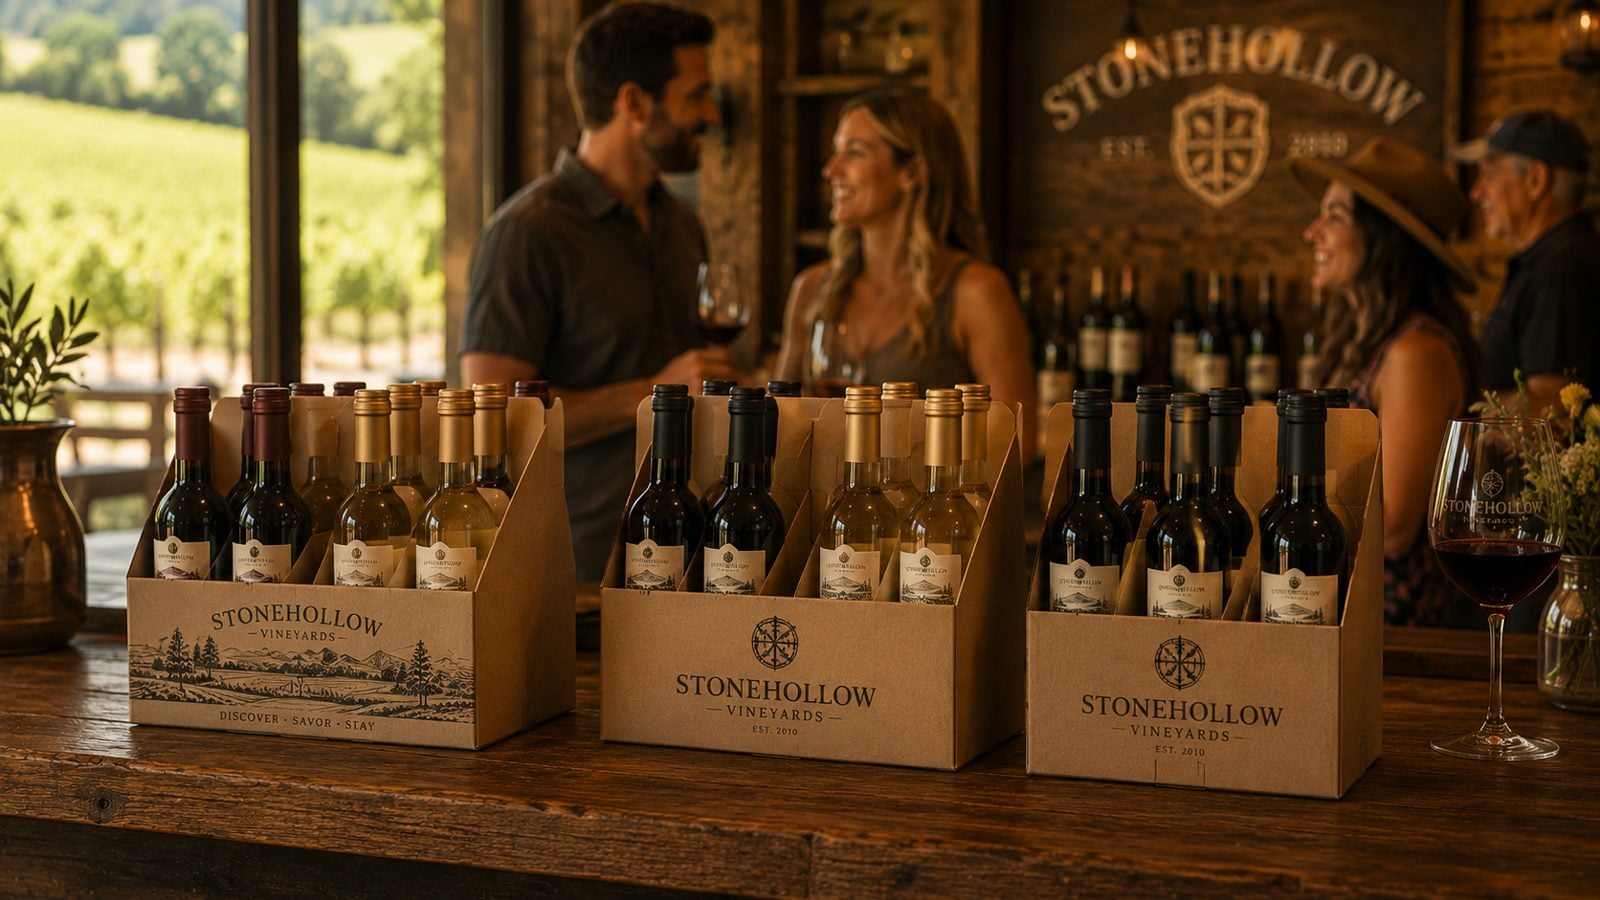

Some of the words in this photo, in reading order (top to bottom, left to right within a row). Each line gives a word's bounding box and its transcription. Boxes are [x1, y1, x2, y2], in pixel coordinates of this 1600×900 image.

[1042, 23, 1427, 133] STONEHOLLOW
[1443, 499, 1543, 515] STONEHOLLOW
[211, 604, 383, 637] STONEHOLLOW
[260, 629, 335, 641] VINEYARDS
[676, 673, 876, 708] STONEHOLLOW
[727, 705, 823, 722] VINEYARDS
[1081, 694, 1283, 727] STONEHOLLOW
[219, 711, 279, 724] DISCOVER
[292, 716, 332, 728] SAVOR
[752, 725, 773, 735] EST.
[777, 726, 798, 736] 2010
[1130, 724, 1230, 742] VINEYARDS
[1155, 745, 1177, 755] EST.
[1182, 747, 1205, 757] 2010
